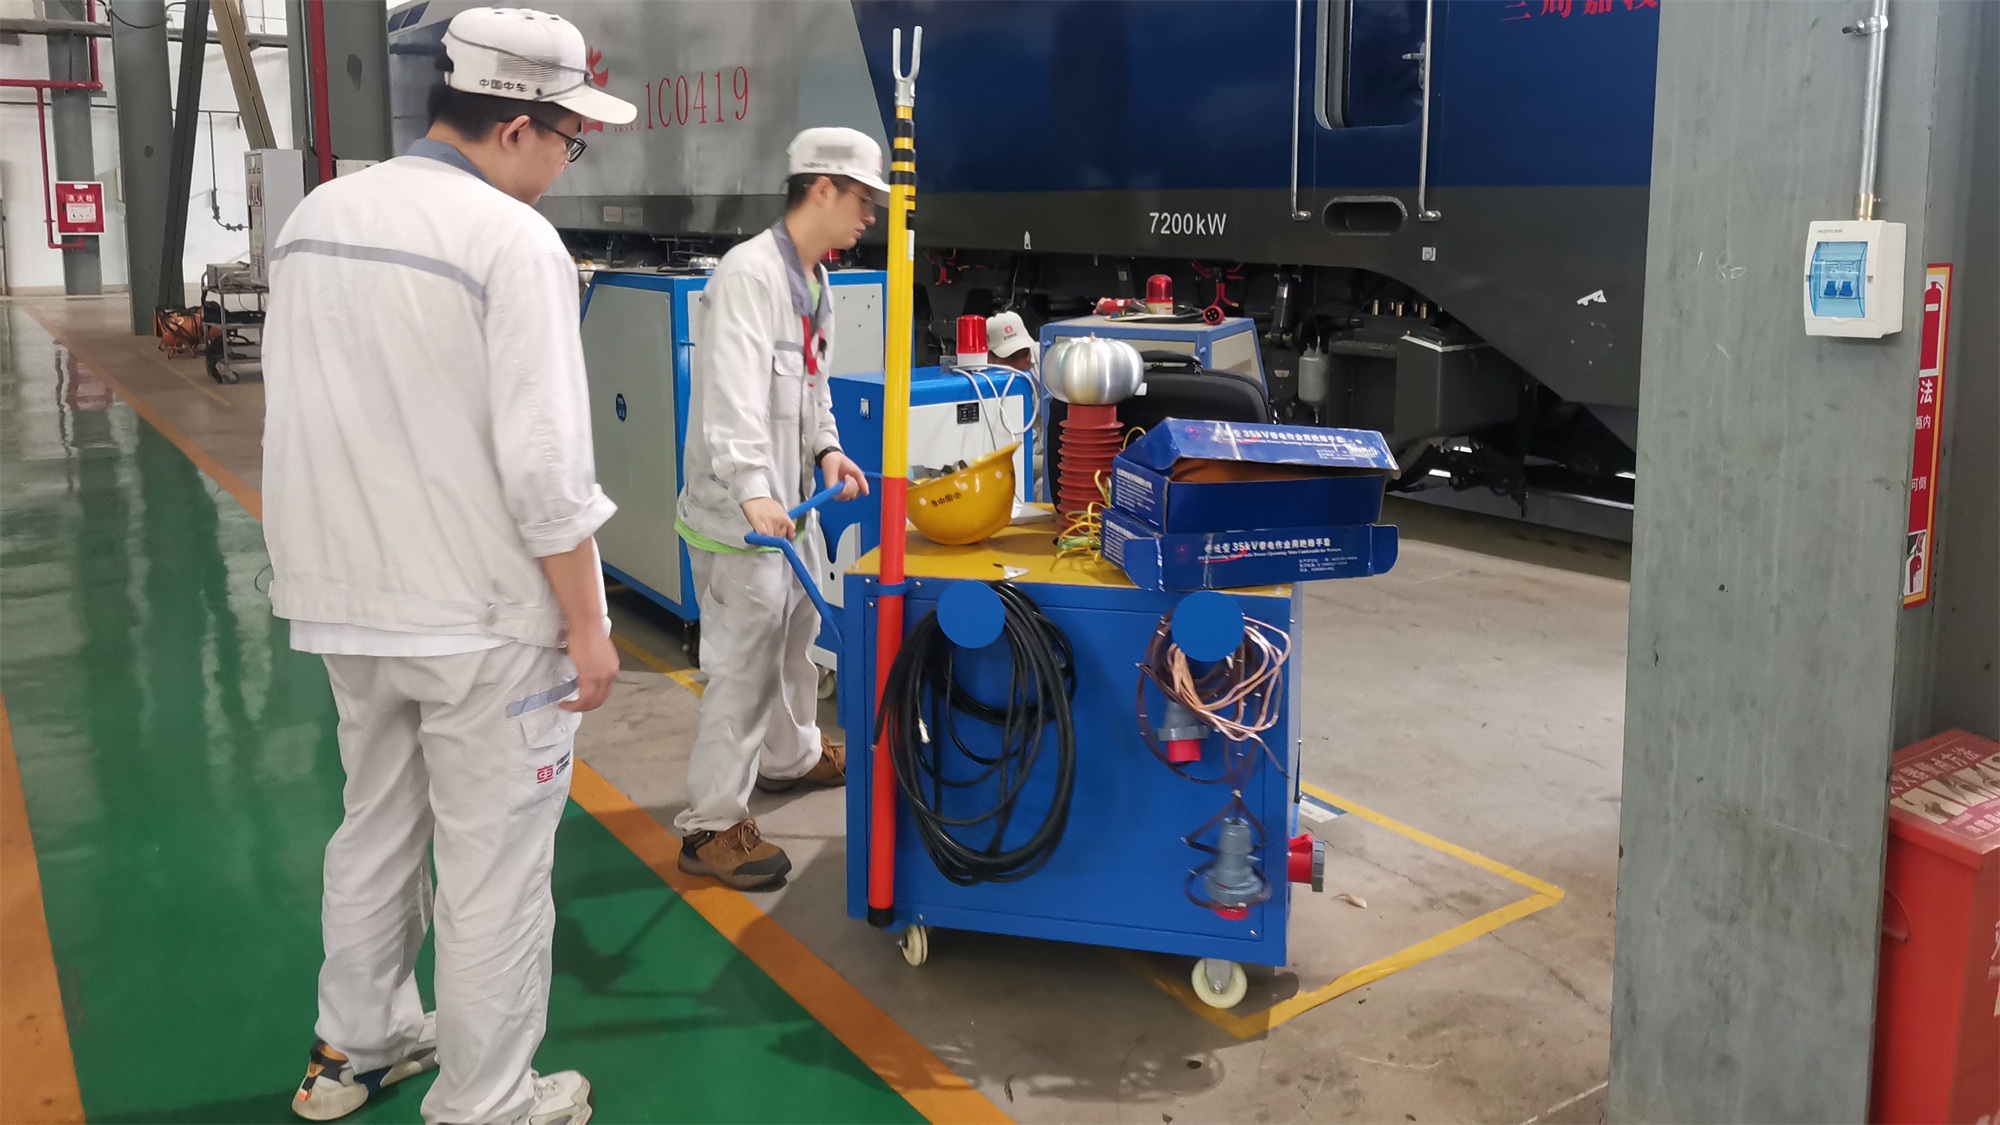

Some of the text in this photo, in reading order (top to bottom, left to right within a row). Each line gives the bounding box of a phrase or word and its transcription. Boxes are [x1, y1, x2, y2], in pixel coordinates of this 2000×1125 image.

[479, 78, 527, 93] 中国中车
[1149, 212, 1227, 236] 7200kW
